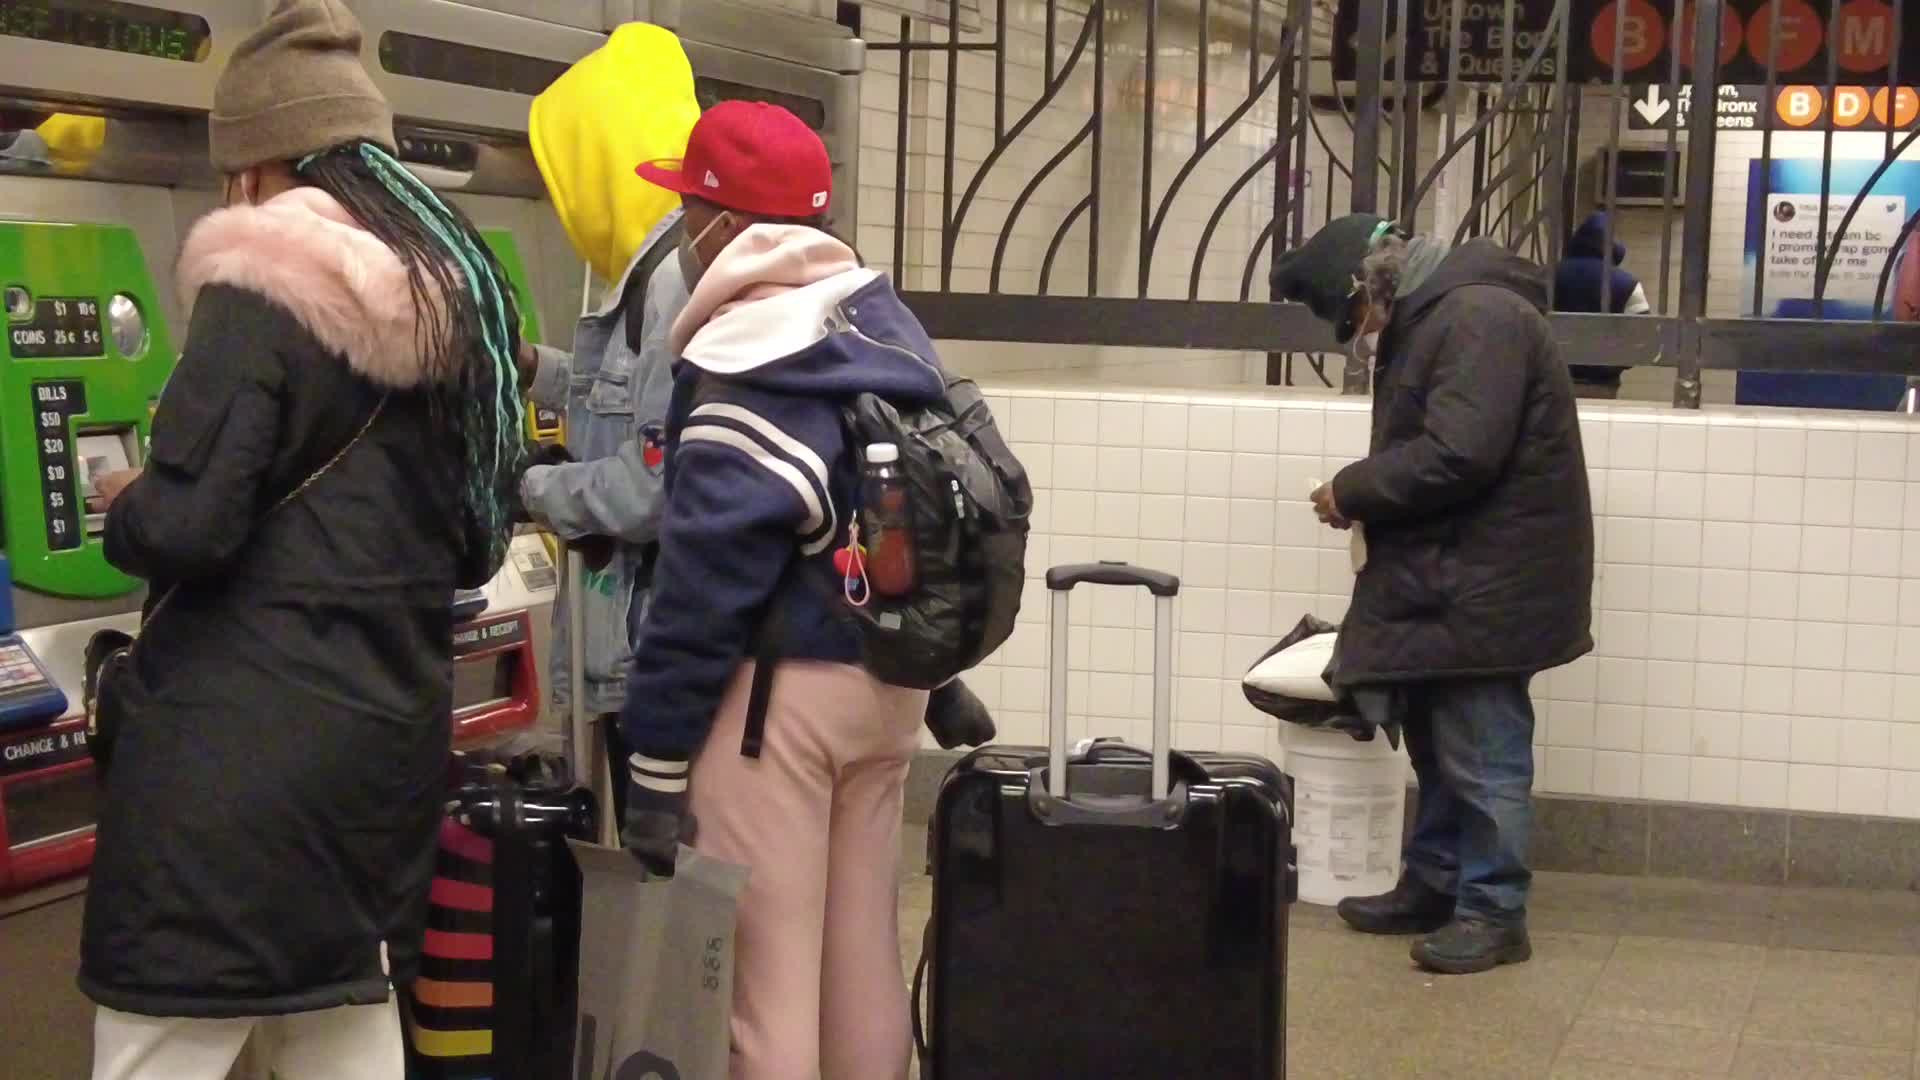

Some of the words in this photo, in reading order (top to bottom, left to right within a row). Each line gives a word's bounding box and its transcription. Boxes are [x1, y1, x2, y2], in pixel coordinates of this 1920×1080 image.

[1843, 16, 1886, 55] M
[1420, 51, 1439, 75] &
[1790, 92, 1811, 117] B
[1838, 92, 1860, 117] D
[1779, 229, 1813, 240] need
[1770, 255, 1799, 266] take
[1847, 257, 1868, 267] me
[53, 300, 67, 317] $1
[13, 329, 46, 345] COINS
[37, 386, 68, 401] BILLS
[40, 411, 61, 428] $50
[43, 438, 64, 454] $20
[47, 465, 65, 481] $10
[49, 491, 64, 508] $5
[53, 518, 66, 534] $1
[4, 737, 55, 761] CHANGE
[60, 733, 69, 750] &
